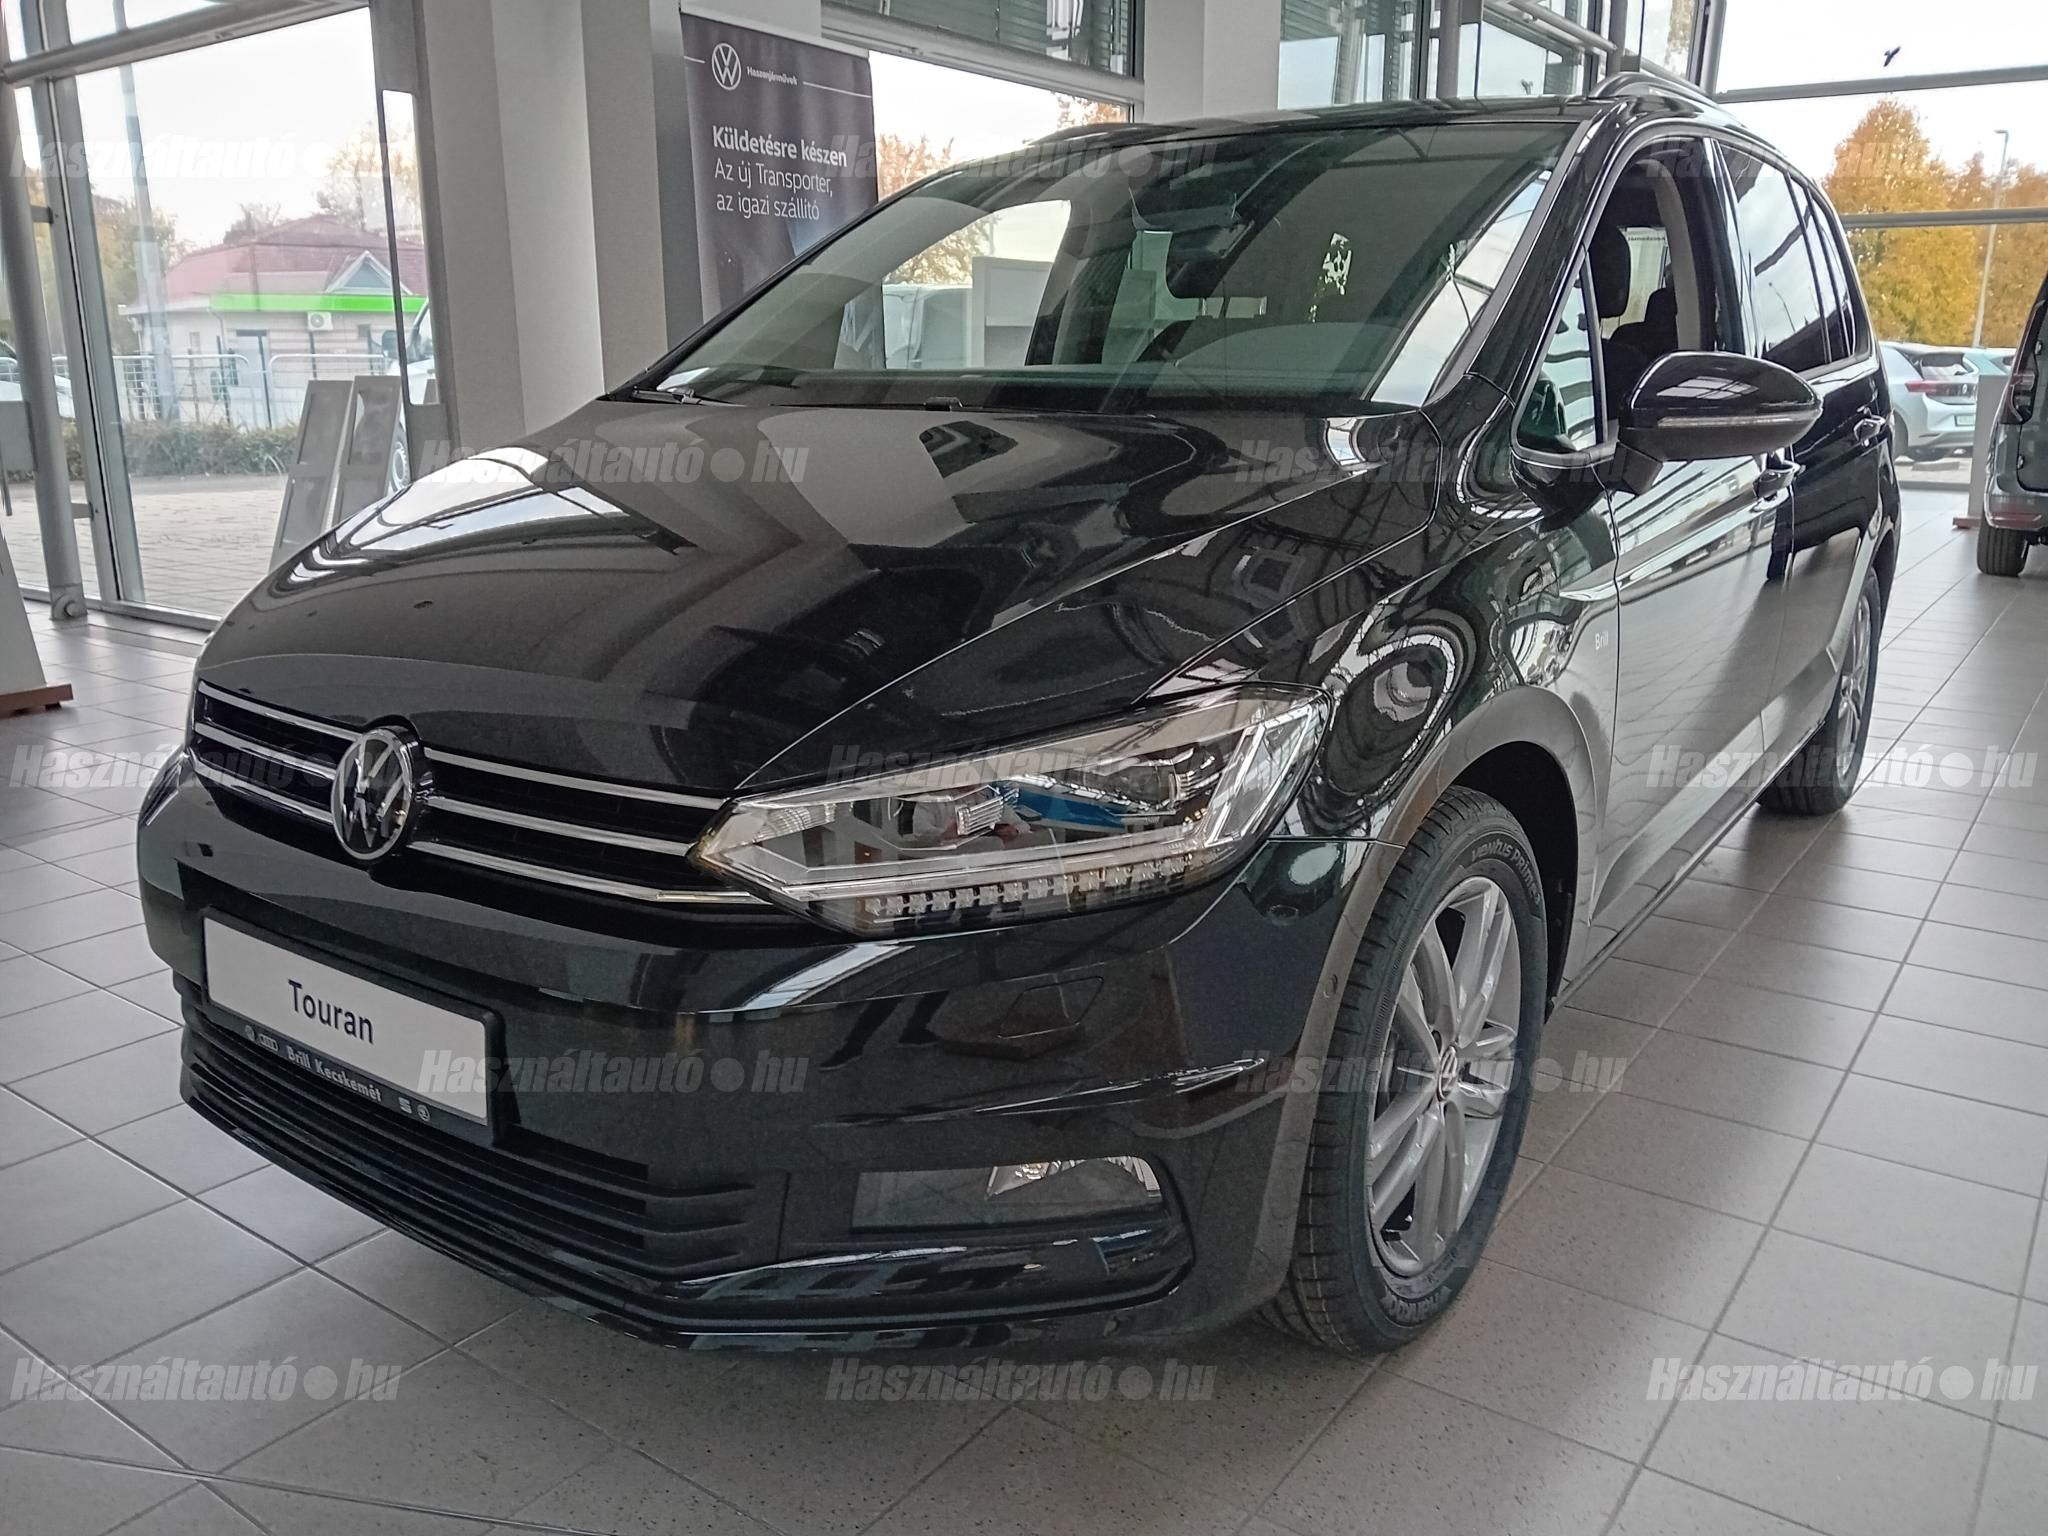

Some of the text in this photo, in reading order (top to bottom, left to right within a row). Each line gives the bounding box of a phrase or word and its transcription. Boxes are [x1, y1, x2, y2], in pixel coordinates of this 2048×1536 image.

[712, 125, 848, 168] Küldetésre készen
[714, 158, 833, 198] Az új Transporter,
[716, 192, 820, 221] az igazi szállító
[288, 978, 374, 1045] Touran
[286, 1045, 382, 1103] Brill Kecskemét
